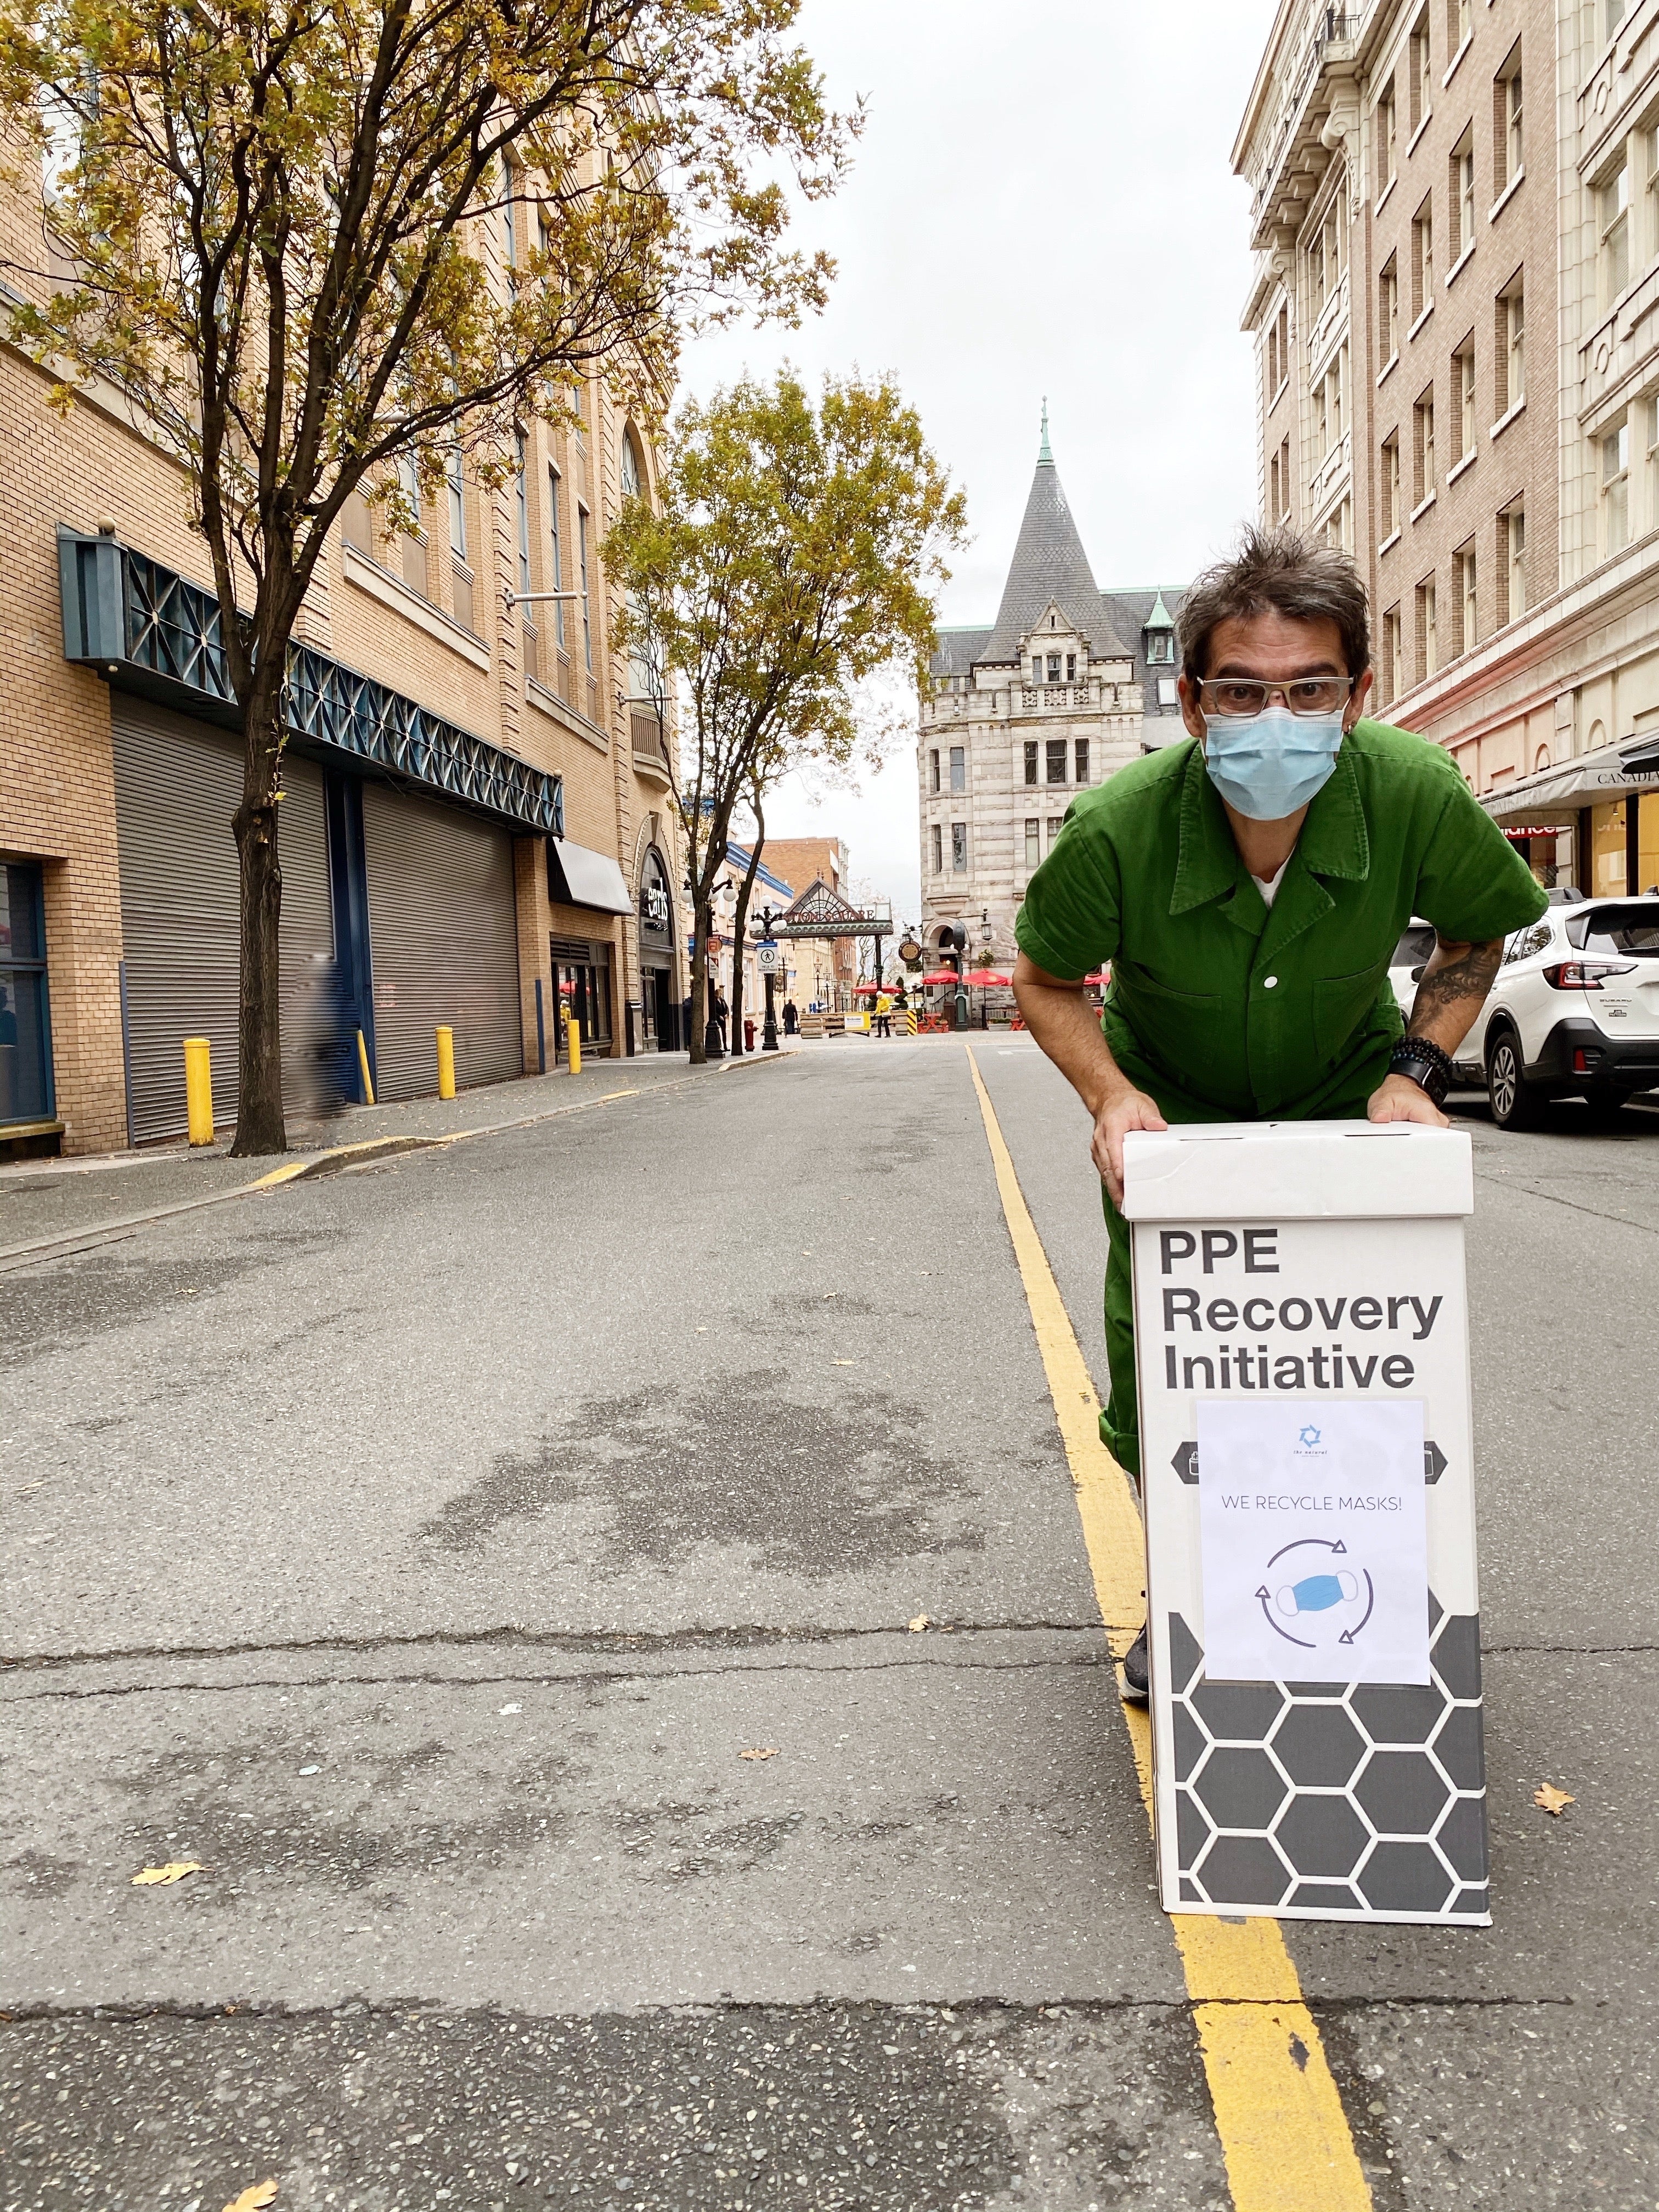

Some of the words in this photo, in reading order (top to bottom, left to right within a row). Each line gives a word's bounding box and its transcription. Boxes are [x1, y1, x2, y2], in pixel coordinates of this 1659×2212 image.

[648, 877, 668, 921] earls
[825, 910, 875, 922] SQUARE
[1160, 1228, 1280, 1274] PPE
[1162, 1288, 1443, 1340] Recovery
[1165, 1344, 1414, 1389] Initiative
[1221, 1495, 1250, 1509] WE
[1256, 1496, 1333, 1510] RECYCLE
[1339, 1497, 1402, 1510] MASKS!
